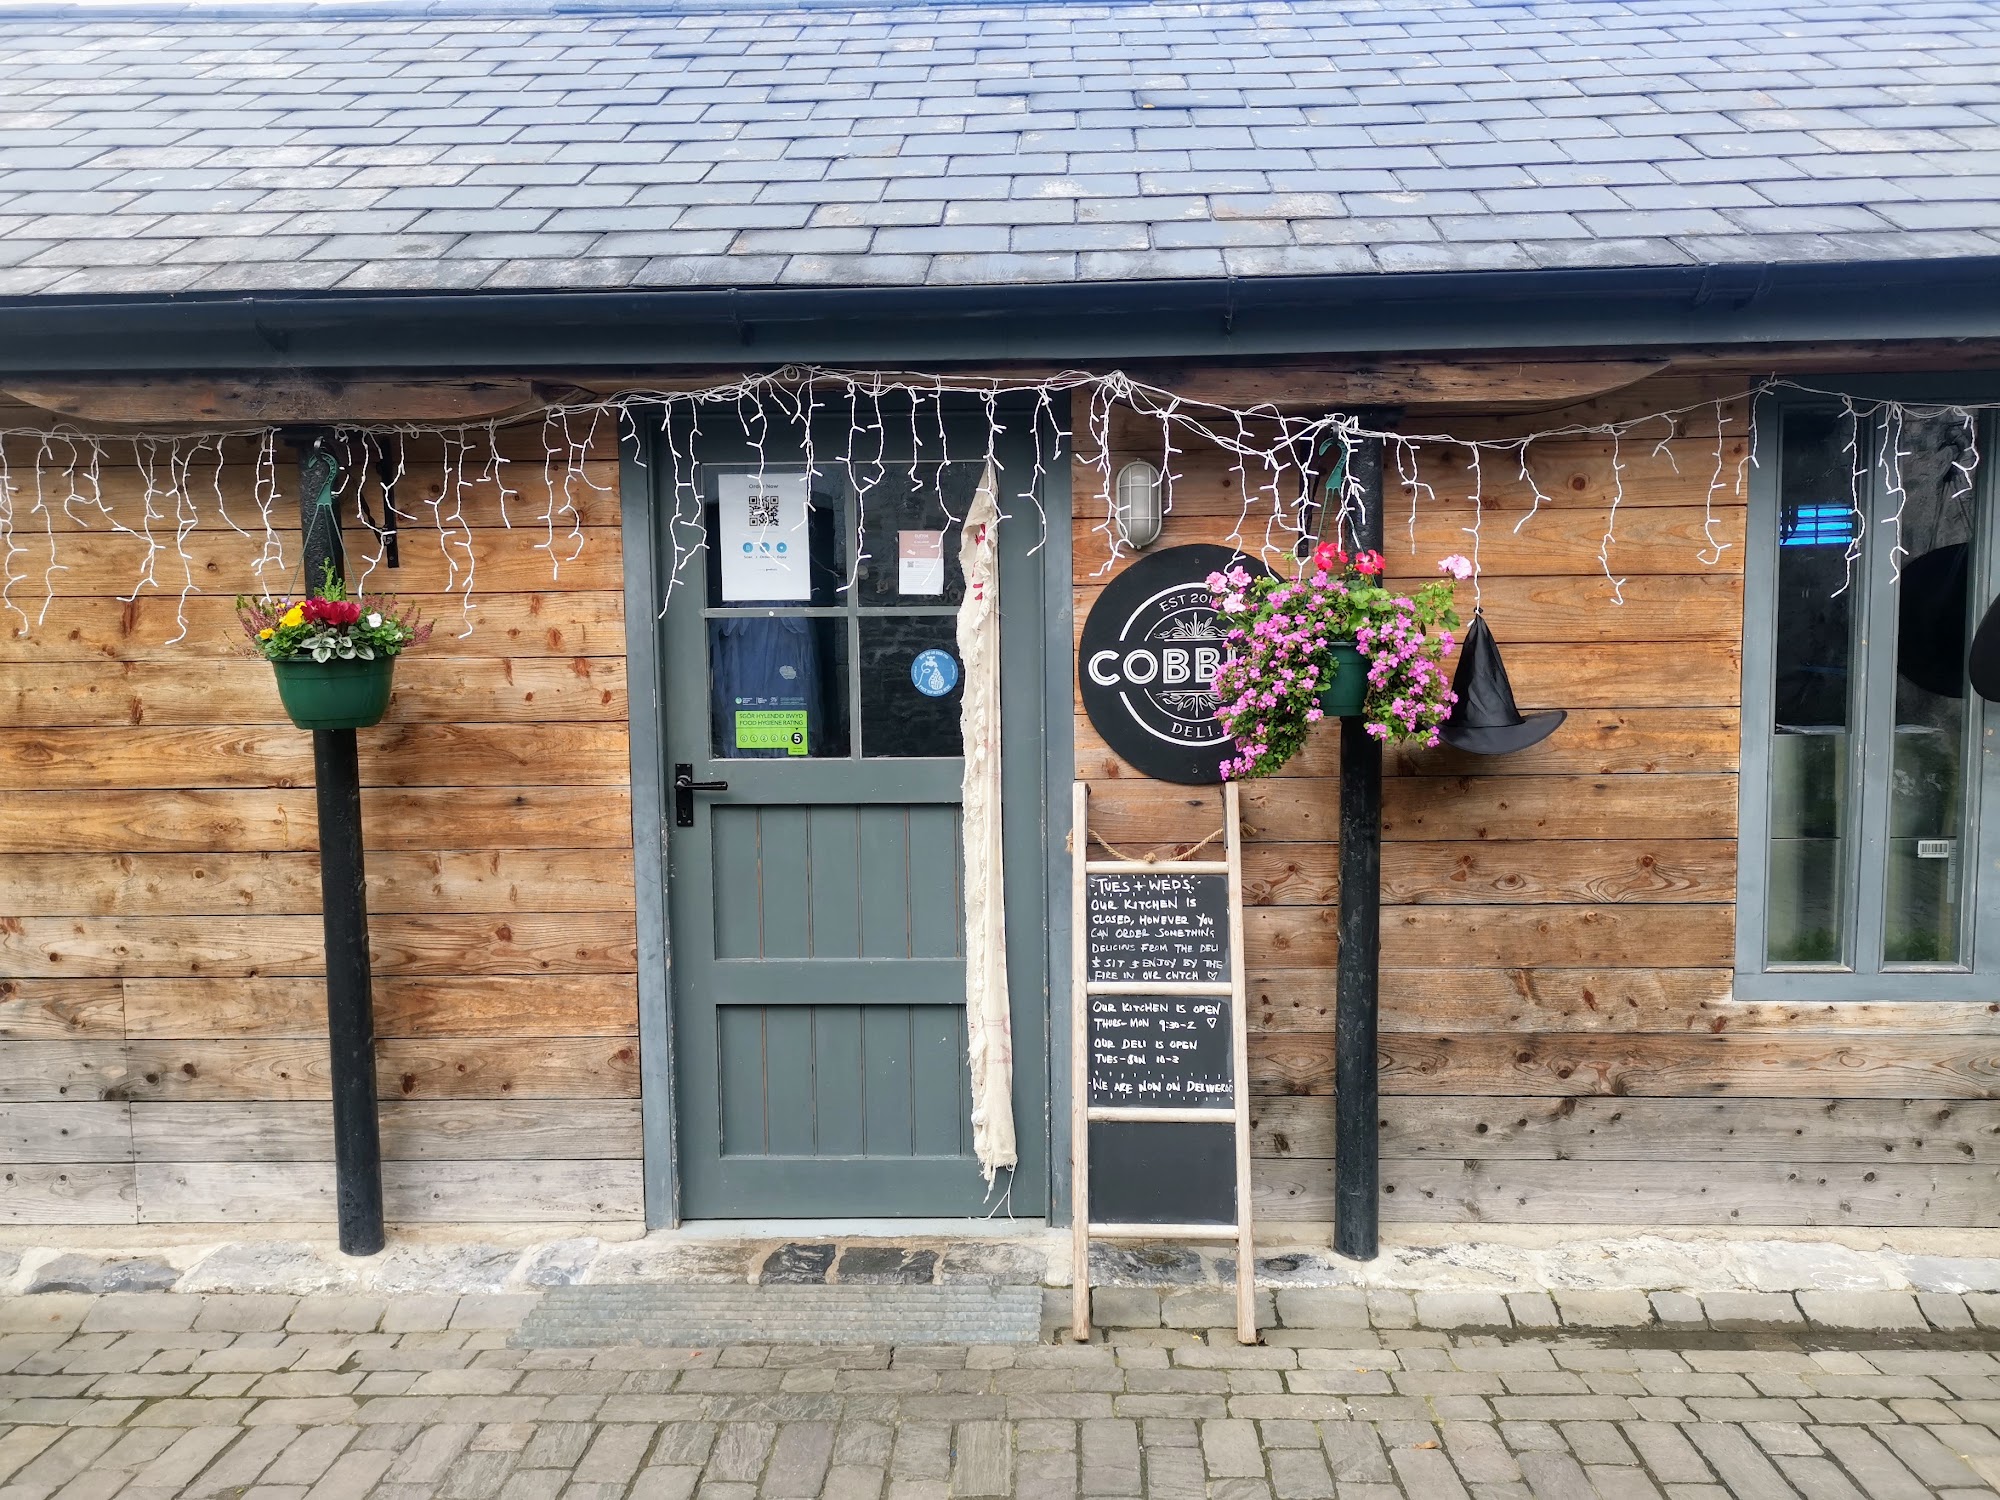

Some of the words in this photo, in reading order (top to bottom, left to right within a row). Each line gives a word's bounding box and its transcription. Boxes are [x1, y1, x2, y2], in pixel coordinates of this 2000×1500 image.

[1159, 594, 1186, 612] EST
[1190, 593, 1212, 604] 201
[794, 734, 800, 744] 5
[1091, 878, 1130, 894] TUES
[1133, 882, 1146, 891] +
[1091, 900, 1118, 910] OUR
[1124, 897, 1177, 910] KITCHEN
[1186, 898, 1196, 907] IS
[1092, 915, 1134, 926] CLOSED,
[1140, 914, 1189, 926] HOWEVER
[1196, 912, 1213, 926] YOU
[1090, 927, 1108, 940] CAN
[1116, 928, 1150, 938] ORDER
[1155, 928, 1214, 938] SOMETHING
[1140, 944, 1168, 952] FROM
[1174, 944, 1194, 953] THE
[1200, 944, 1218, 952] DELI
[1104, 959, 1125, 968] SIT
[1142, 958, 1177, 968] ENJOY
[1183, 959, 1198, 968] BY
[1203, 960, 1222, 968] THE
[1095, 971, 1118, 982] FIRE
[1124, 972, 1134, 980] IN
[1093, 1001, 1116, 1012] OUR
[1122, 1002, 1168, 1012] KITCHEN
[1176, 1004, 1186, 1013] IS
[1193, 1002, 1220, 1015] OPEN
[1094, 1038, 1115, 1048] OUR
[1122, 1038, 1146, 1050] DELI
[1156, 1040, 1164, 1048] IS
[1170, 1040, 1198, 1050] OPEN
[1114, 1082, 1132, 1094] ARE
[1138, 1080, 1161, 1092] NOW
[1166, 1082, 1180, 1092] ON
